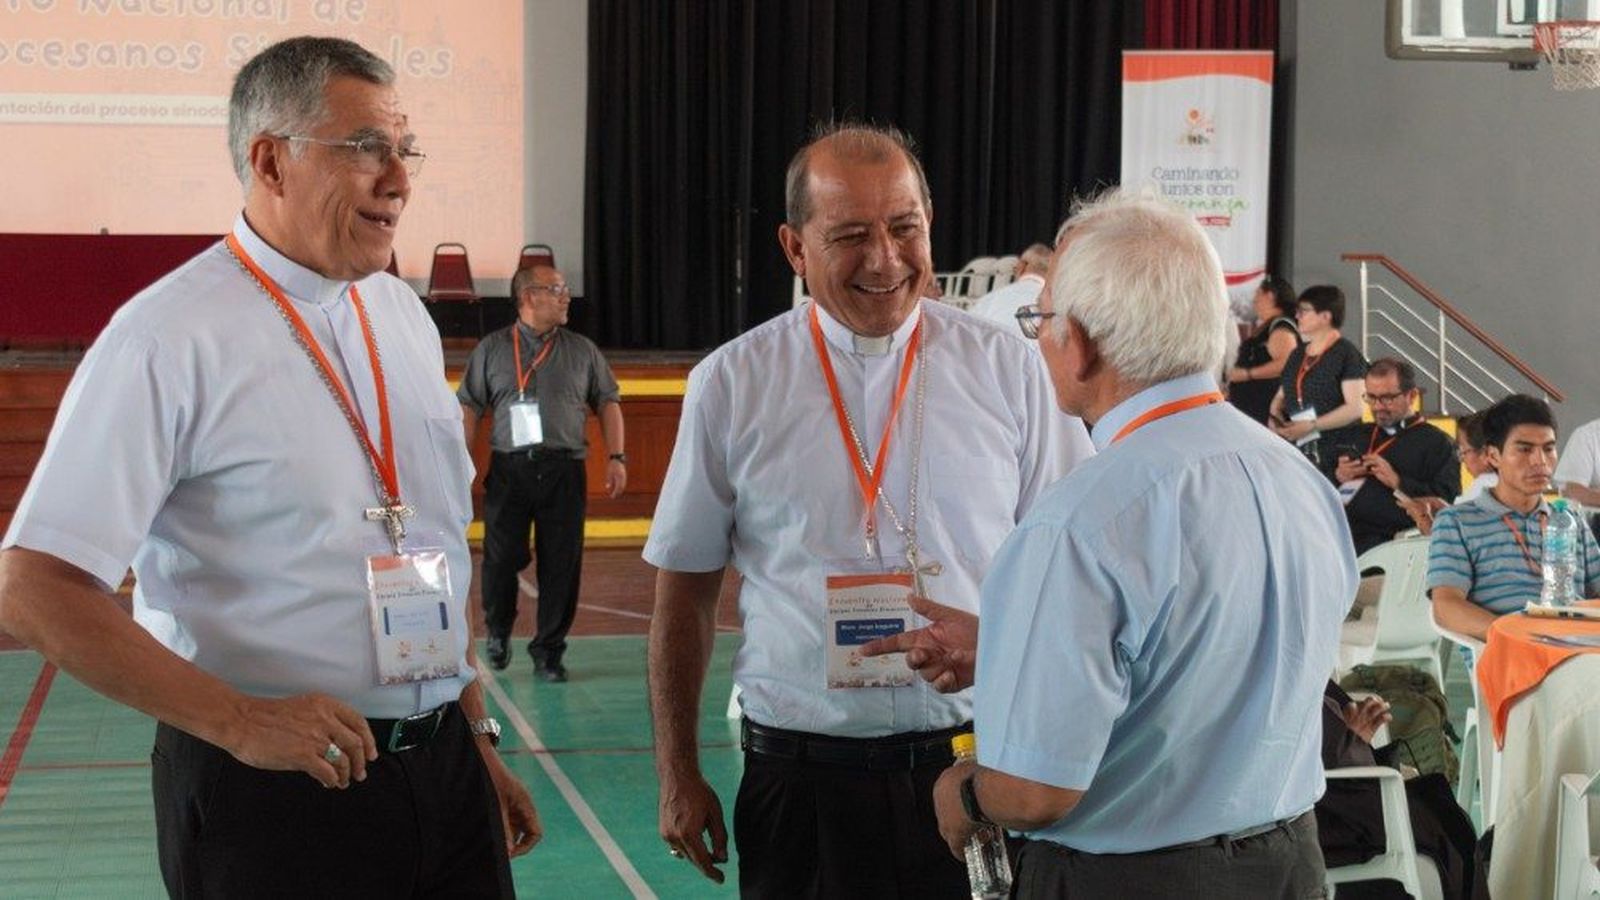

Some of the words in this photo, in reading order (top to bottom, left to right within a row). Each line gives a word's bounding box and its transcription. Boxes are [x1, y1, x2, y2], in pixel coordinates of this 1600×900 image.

[70, 103, 96, 116] del
[100, 104, 168, 118] proceso
[1151, 166, 1240, 181] Caminando
